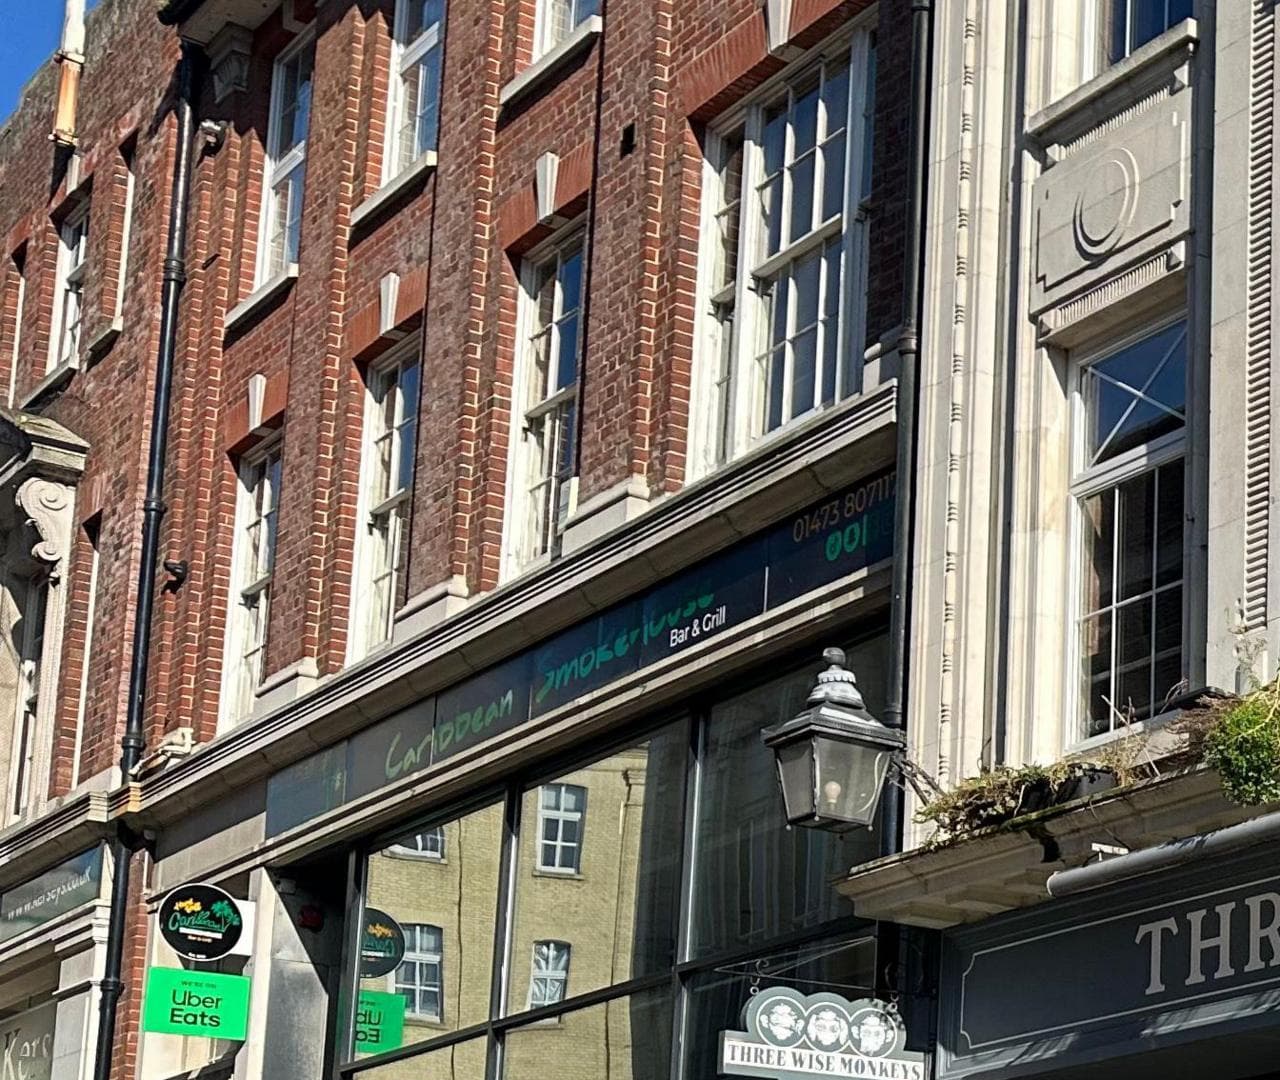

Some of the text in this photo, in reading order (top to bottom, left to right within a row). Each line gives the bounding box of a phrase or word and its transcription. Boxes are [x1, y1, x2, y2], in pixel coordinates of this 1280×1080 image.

[793, 499, 840, 543] 01473
[669, 604, 727, 648] Bar & Grill
[171, 988, 223, 1009] Uber
[169, 1007, 221, 1028] Eats
[728, 1044, 921, 1080] THREE WISE MONKEYS
